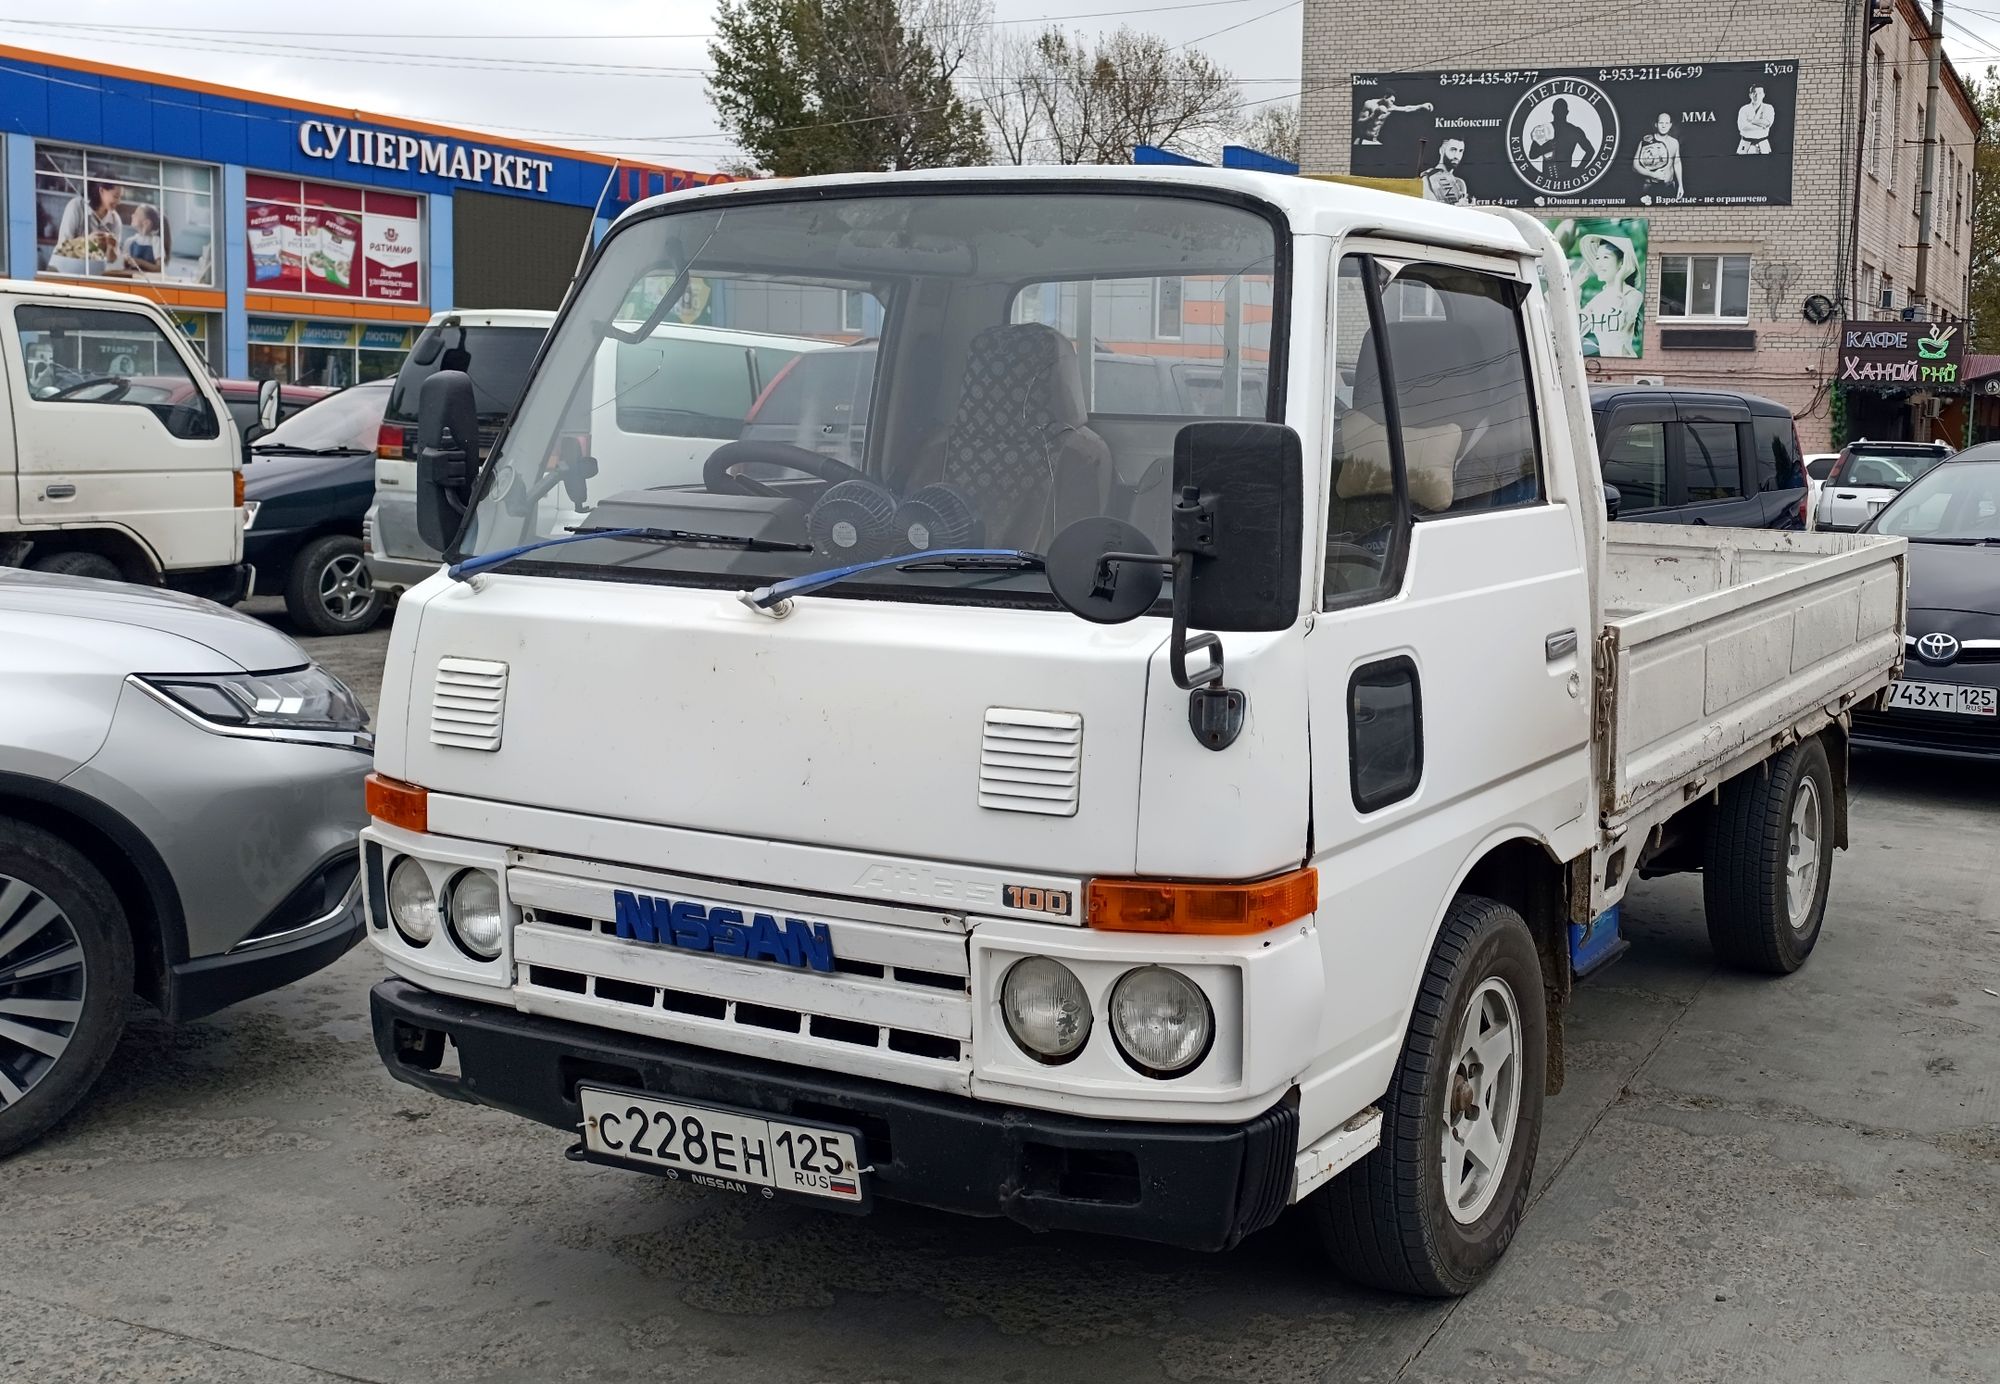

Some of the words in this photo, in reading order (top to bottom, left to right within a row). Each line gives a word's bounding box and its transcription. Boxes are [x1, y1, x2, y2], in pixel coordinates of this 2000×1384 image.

[1599, 66, 1703, 82] 8-953-211-66-99
[1764, 63, 1794, 76] Кудо
[1353, 75, 1378, 86] Бокс
[1440, 71, 1539, 86] 8-924-435-87-77
[1526, 81, 1602, 107] ЛЕГИОН
[1435, 117, 1502, 128] Кикбоксинг
[1682, 111, 1717, 123] ММА
[300, 120, 552, 193] СУПЕРМАРКЕТ
[1511, 136, 1529, 172] КЛУБ
[1535, 134, 1615, 190] ЕДИНОБОРСТВ
[1497, 196, 1503, 205] 4
[1504, 198, 1519, 206] лет
[1547, 196, 1580, 206] Юноши
[1589, 197, 1626, 207] девушки
[1655, 195, 1697, 206] Взрослые
[1704, 196, 1715, 204] не
[1716, 195, 1768, 205] ограничено
[369, 242, 413, 255] РАТИМИР
[364, 330, 403, 343] ЛЮСТРЫ
[1846, 331, 1908, 349] КАФЕ
[1960, 688, 1991, 706] 125
[1965, 704, 1982, 713] RUS
[1007, 885, 1068, 915] 100
[614, 889, 835, 973] NISSAN
[600, 1106, 768, 1178] С228ЕН
[776, 1130, 844, 1175] 125
[691, 1173, 748, 1195] NISSAN
[795, 1172, 829, 1189] RUS
